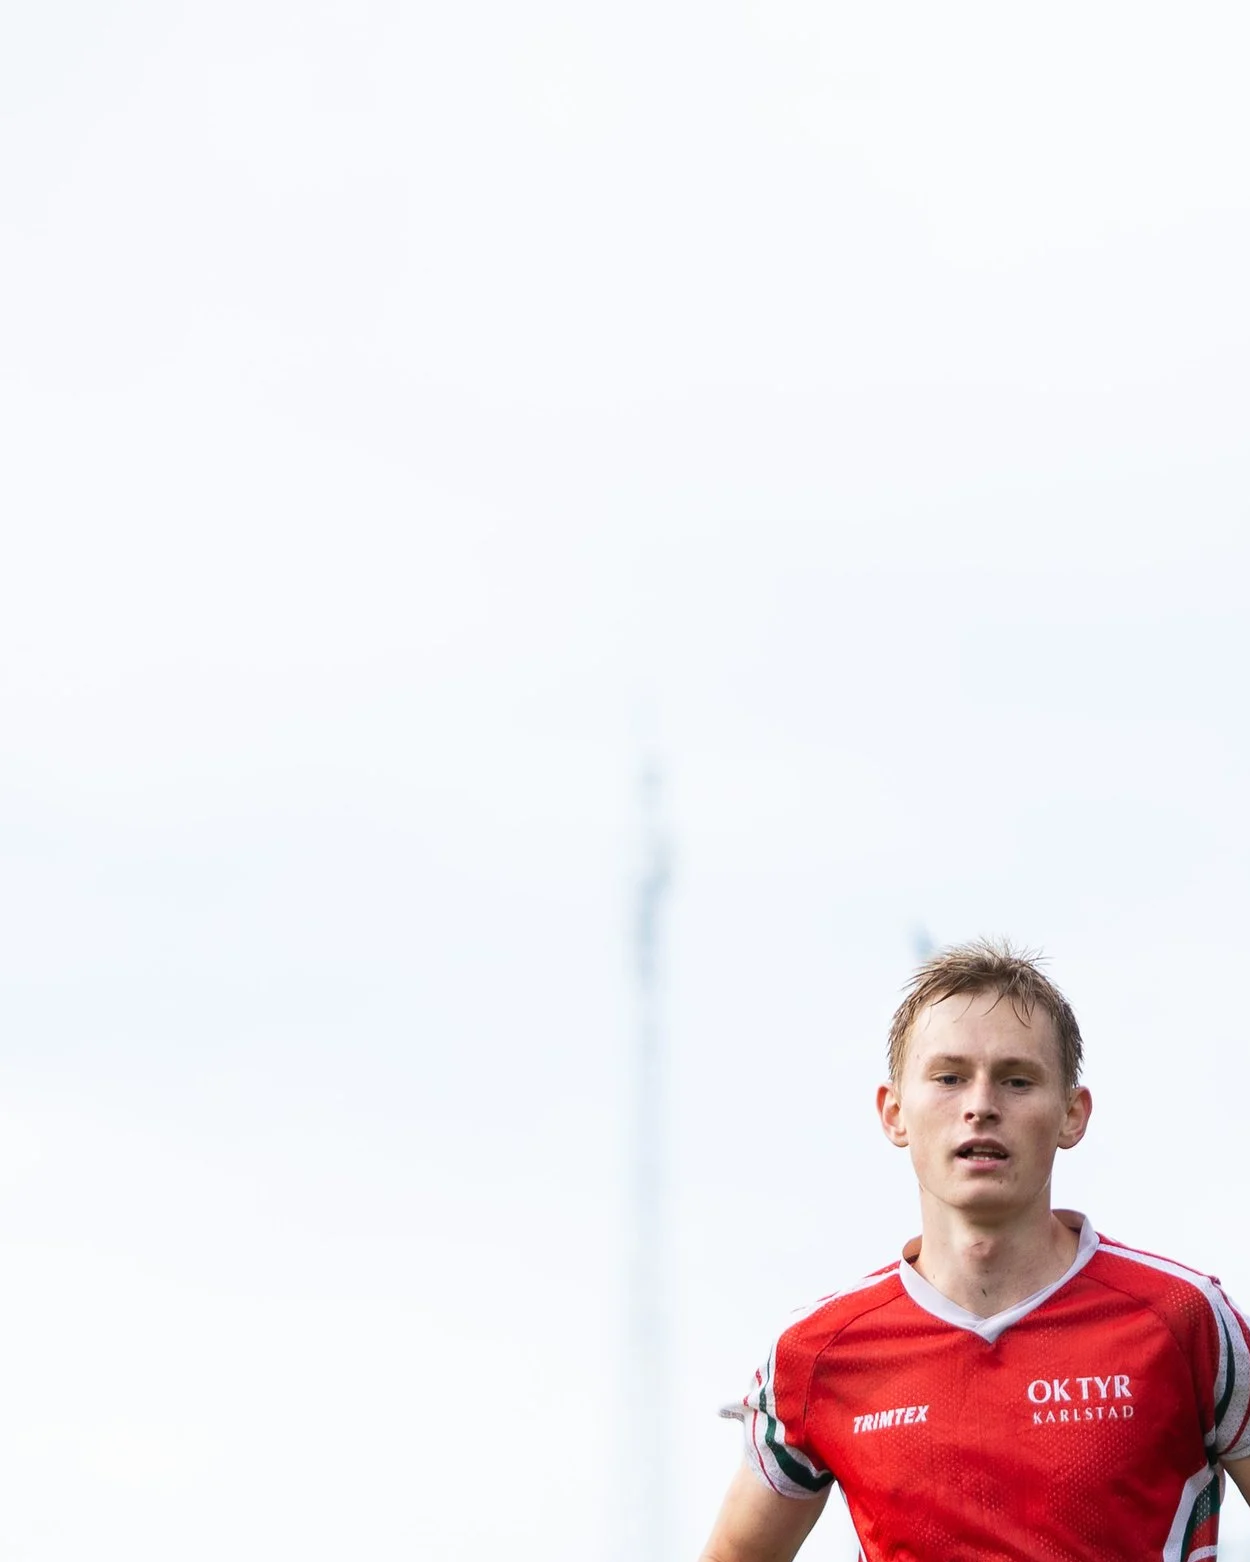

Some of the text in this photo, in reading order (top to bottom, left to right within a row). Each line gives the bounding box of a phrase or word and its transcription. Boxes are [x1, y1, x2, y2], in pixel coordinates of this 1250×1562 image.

[1027, 1374, 1133, 1404] OK TYR
[853, 1404, 930, 1434] TRIMTEX
[1033, 1405, 1134, 1425] KARLSTAD
